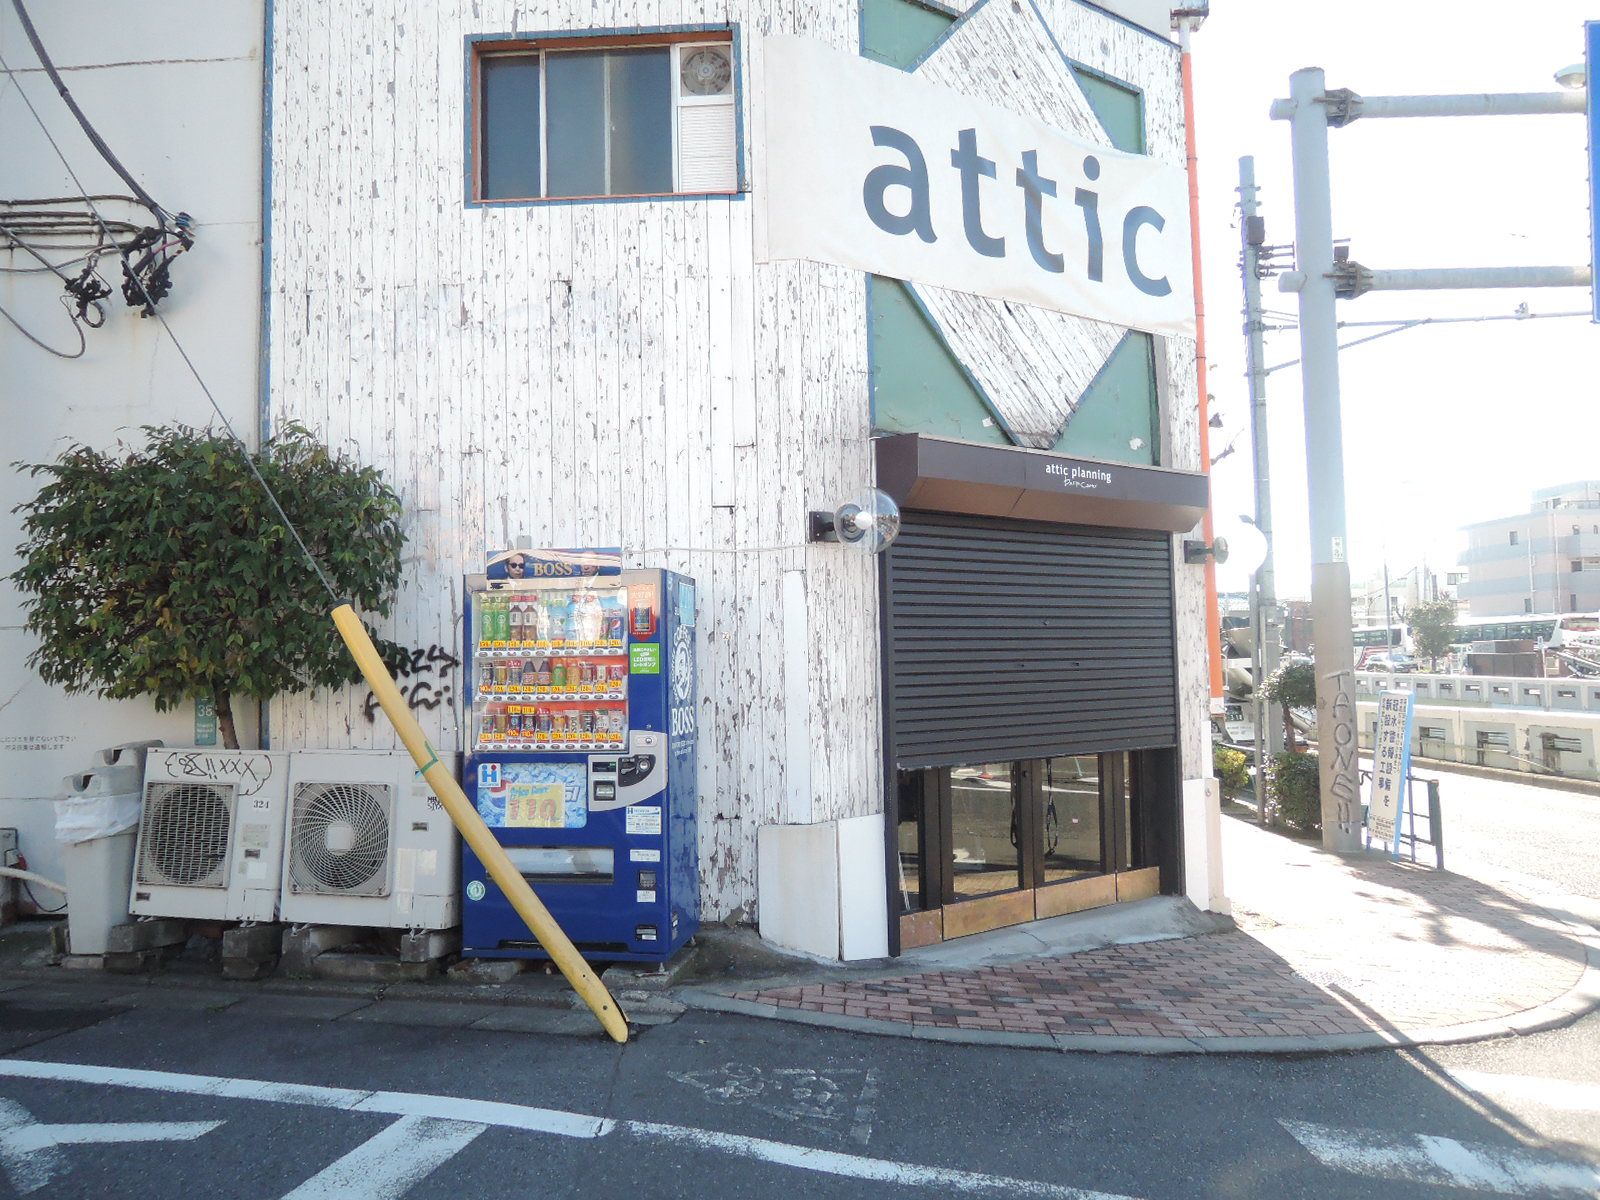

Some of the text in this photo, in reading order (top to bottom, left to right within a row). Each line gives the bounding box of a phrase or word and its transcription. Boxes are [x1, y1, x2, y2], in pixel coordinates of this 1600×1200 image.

[863, 126, 1172, 297] attic
[1045, 464, 1111, 483] attic planning
[532, 562, 573, 577] BOSS
[671, 705, 694, 737] BOSS
